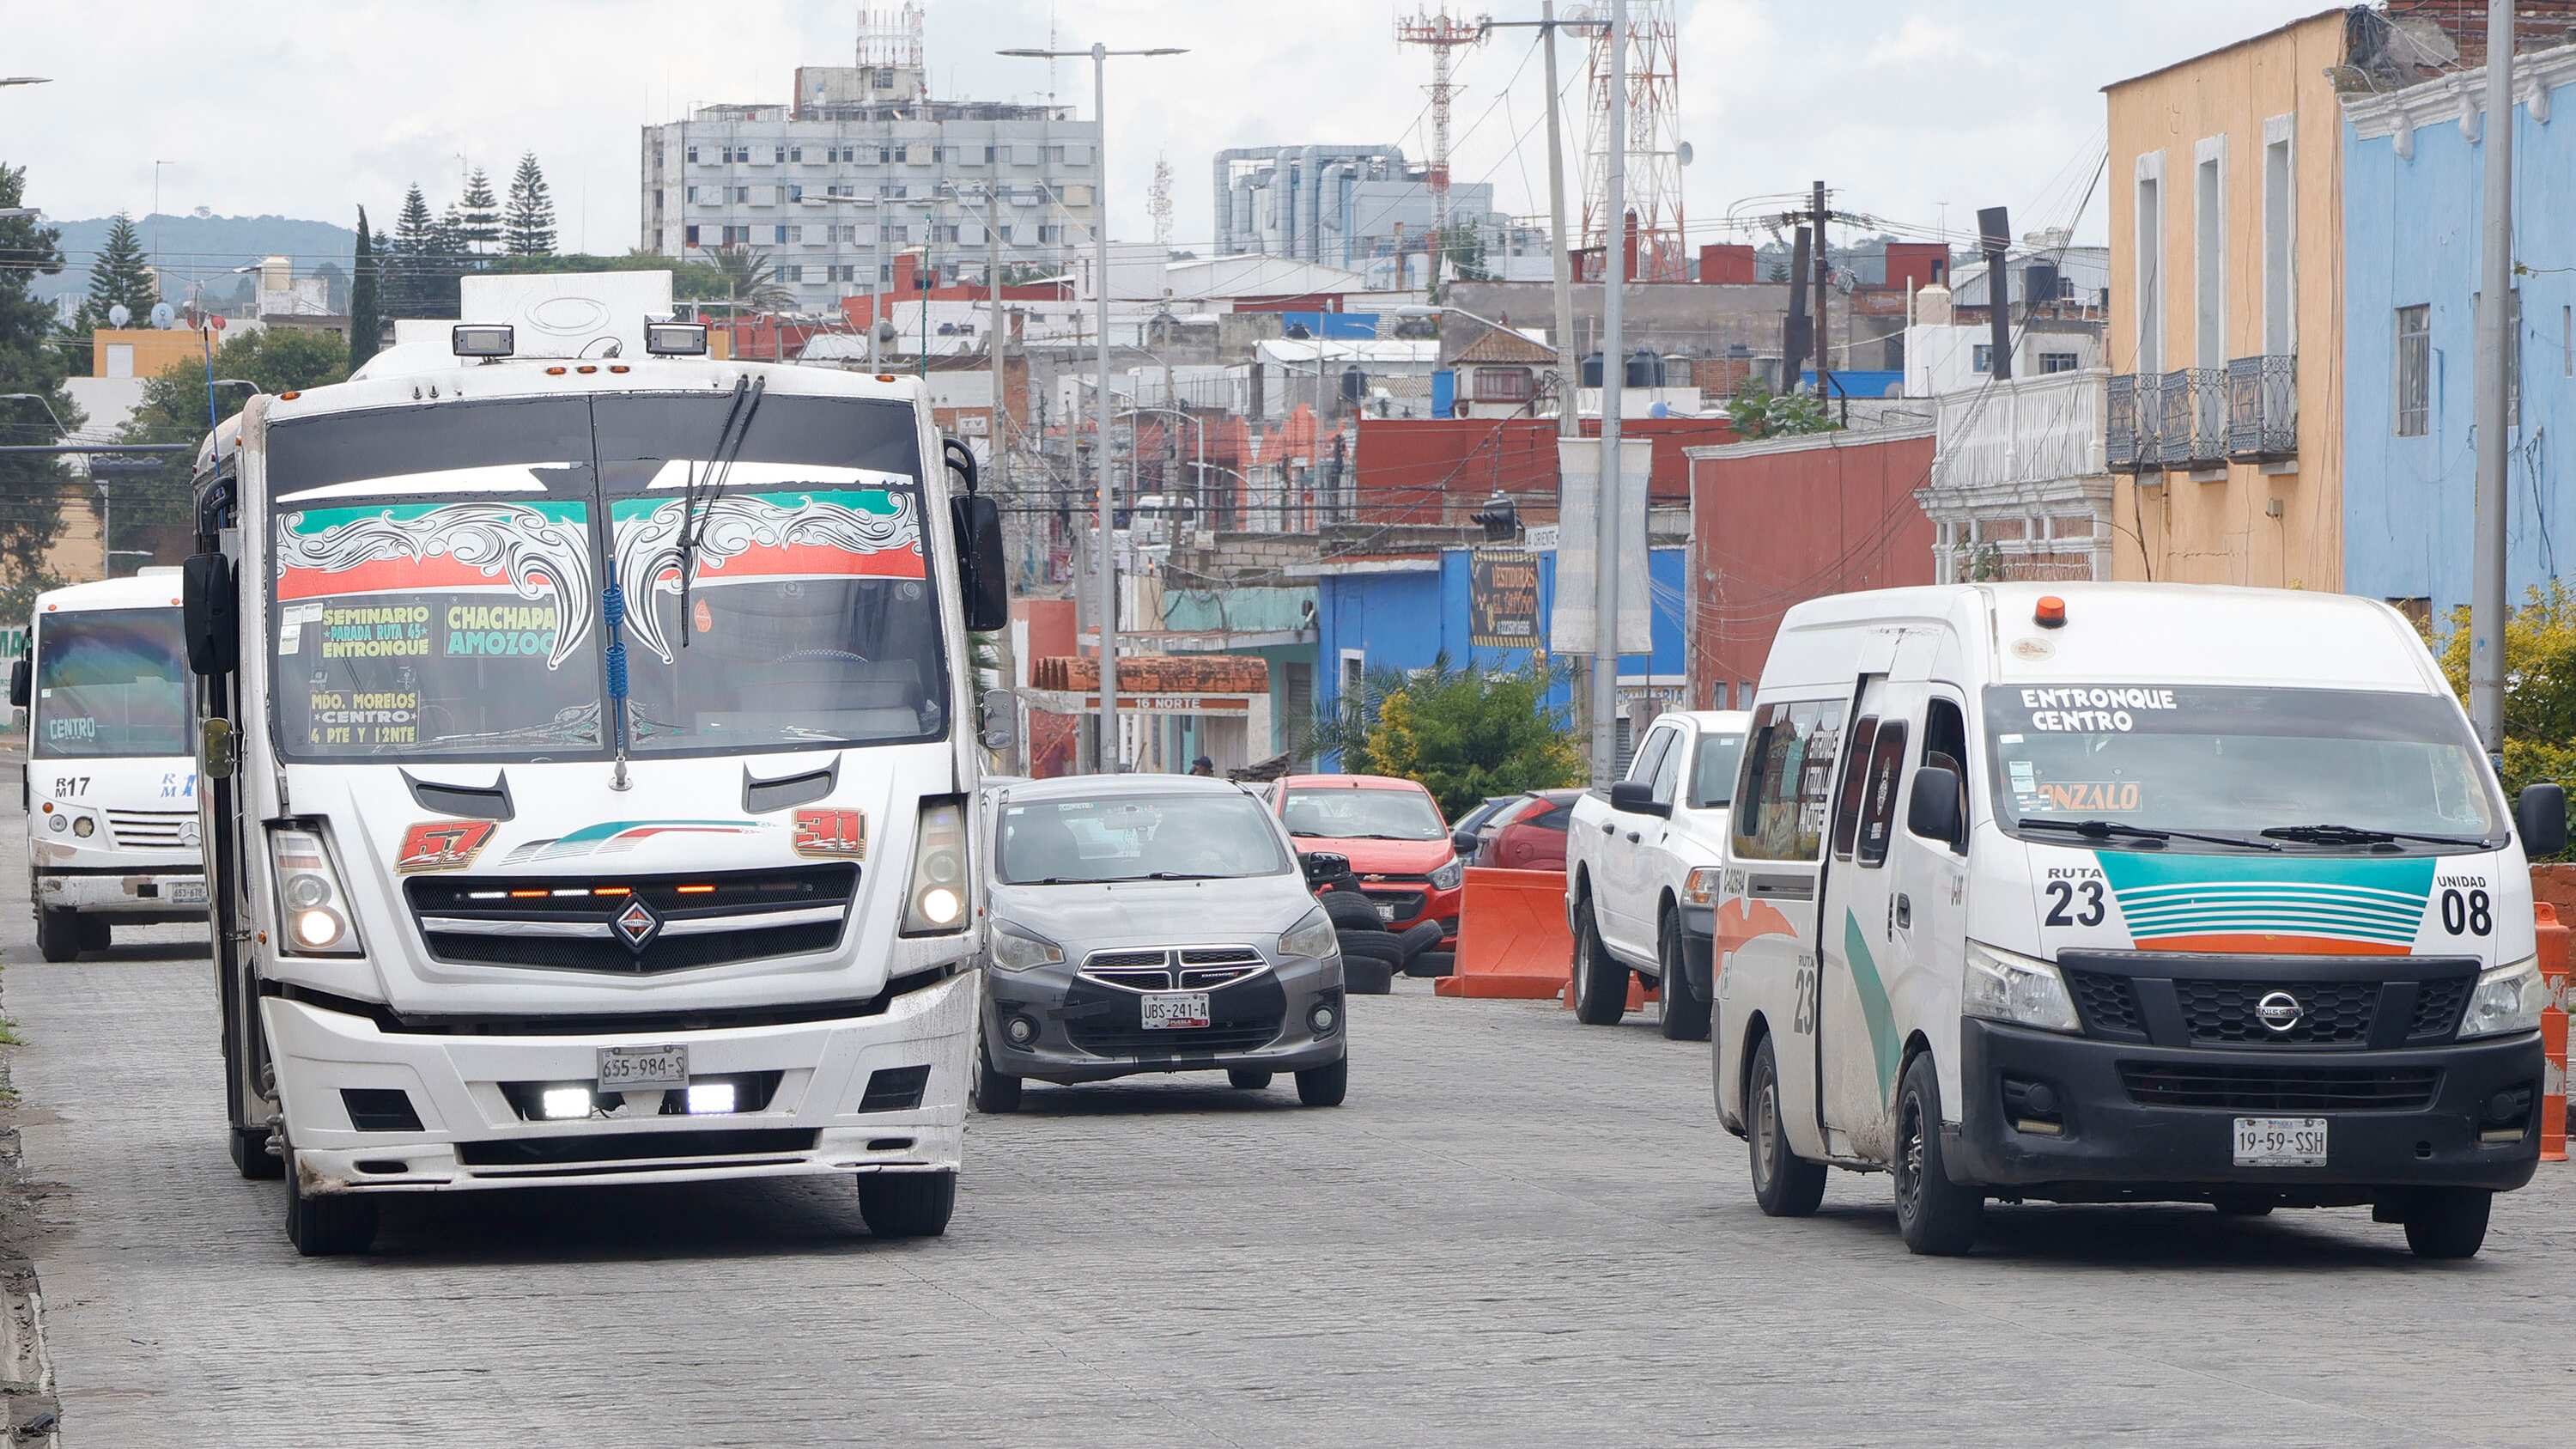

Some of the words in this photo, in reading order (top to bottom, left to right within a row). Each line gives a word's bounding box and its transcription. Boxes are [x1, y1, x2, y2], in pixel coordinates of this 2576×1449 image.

[323, 606, 429, 626] SEMINARIO
[447, 606, 556, 630] CHACHAPA
[331, 624, 372, 642] PARADA
[377, 624, 403, 641] RUTA
[322, 639, 429, 658] ENTRONQUE
[311, 694, 345, 710] MDO.
[353, 692, 416, 709] MORELOS
[1135, 698, 1151, 709] 16
[1155, 698, 1201, 709] NORTE
[2020, 688, 2177, 710] ENTRONQUE
[321, 710, 410, 724] CENTRO
[2032, 710, 2133, 732] CENTRO
[49, 717, 95, 740] CENTRO
[326, 727, 350, 743] PTE
[357, 728, 366, 743] Y
[66, 776, 91, 796] 17
[791, 807, 868, 861] 31
[393, 819, 501, 875] 67
[2048, 868, 2103, 880] RUTA
[2437, 875, 2487, 888] UNIDAD
[2044, 880, 2105, 928] 23
[2440, 888, 2492, 936] 08
[1798, 954, 1814, 967] RUTA
[1144, 1002, 1207, 1019] UBS-241-A
[1794, 968, 1815, 1036] 23
[2239, 1131, 2324, 1153] 19-59-SSH
